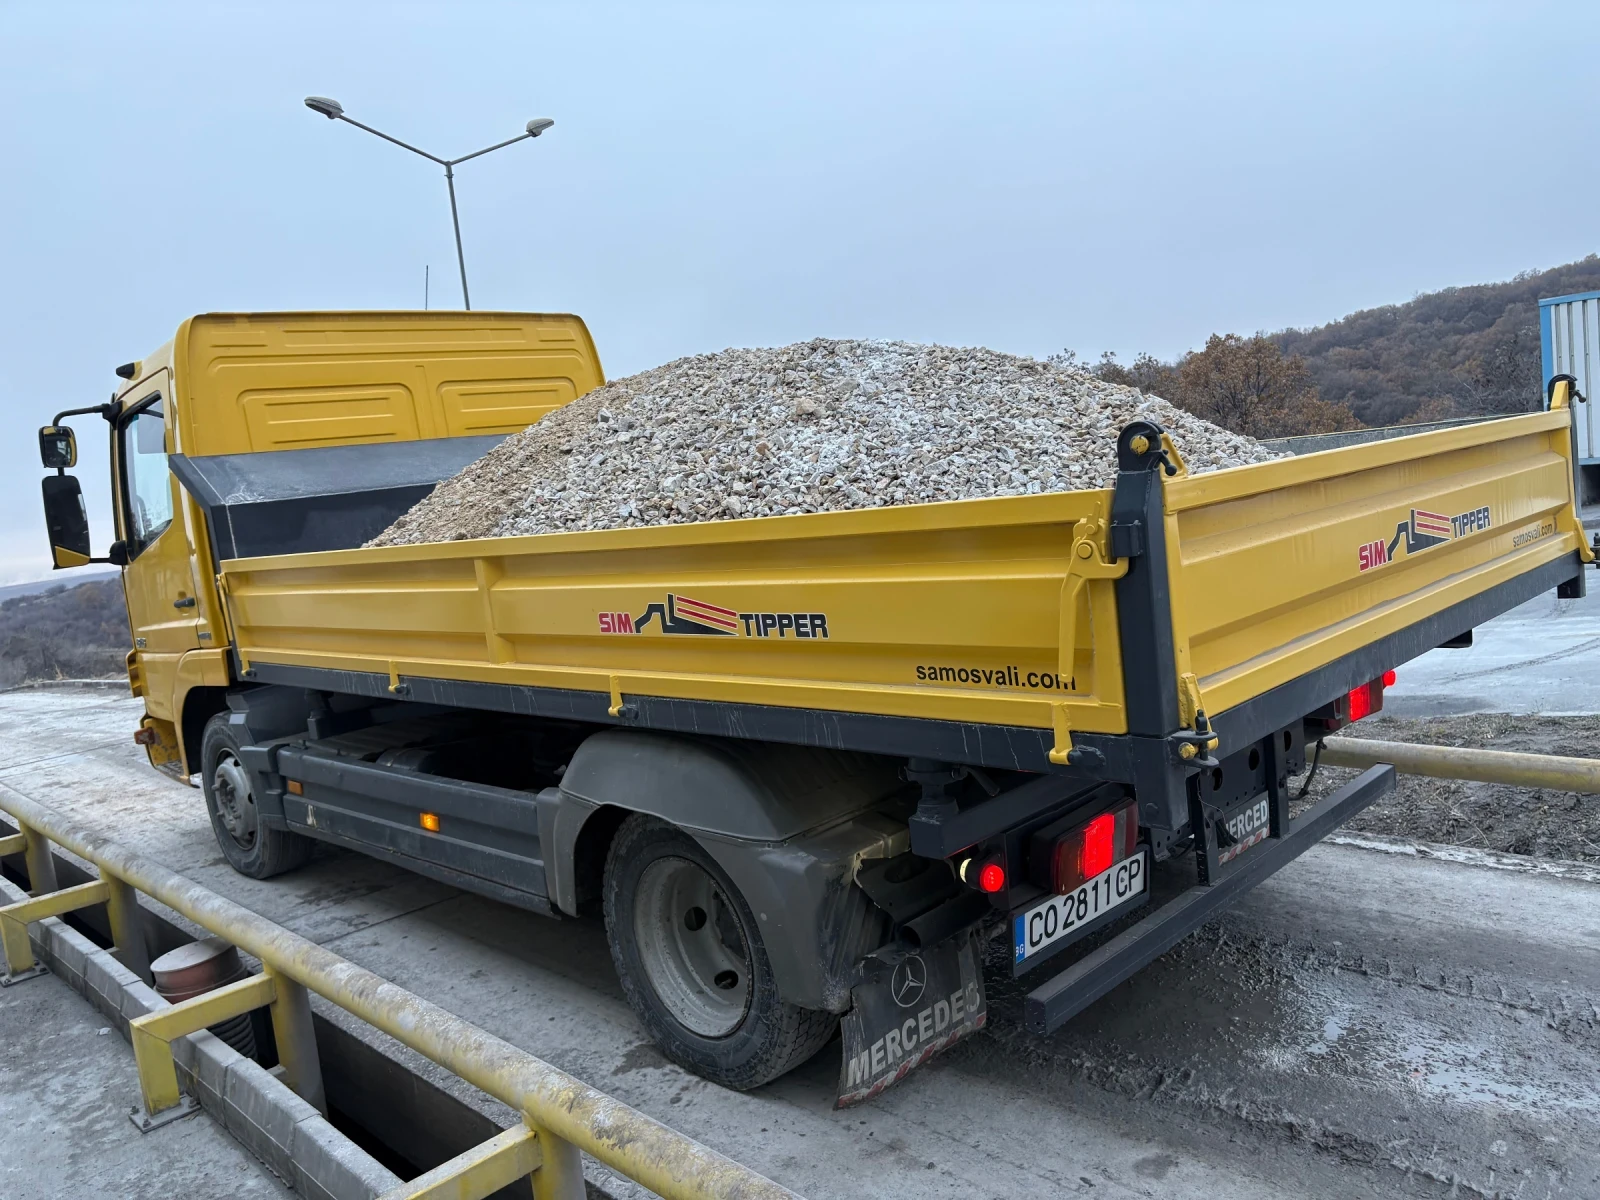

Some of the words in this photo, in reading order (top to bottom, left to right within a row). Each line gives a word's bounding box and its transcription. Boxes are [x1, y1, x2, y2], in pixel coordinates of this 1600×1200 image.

[1358, 538, 1387, 573] SIM
[1450, 506, 1491, 540] TIPPER
[1512, 523, 1553, 548] samosvali.com
[599, 613, 633, 633] SIM
[739, 613, 829, 638] TIPPER
[1226, 799, 1268, 839] ERCED
